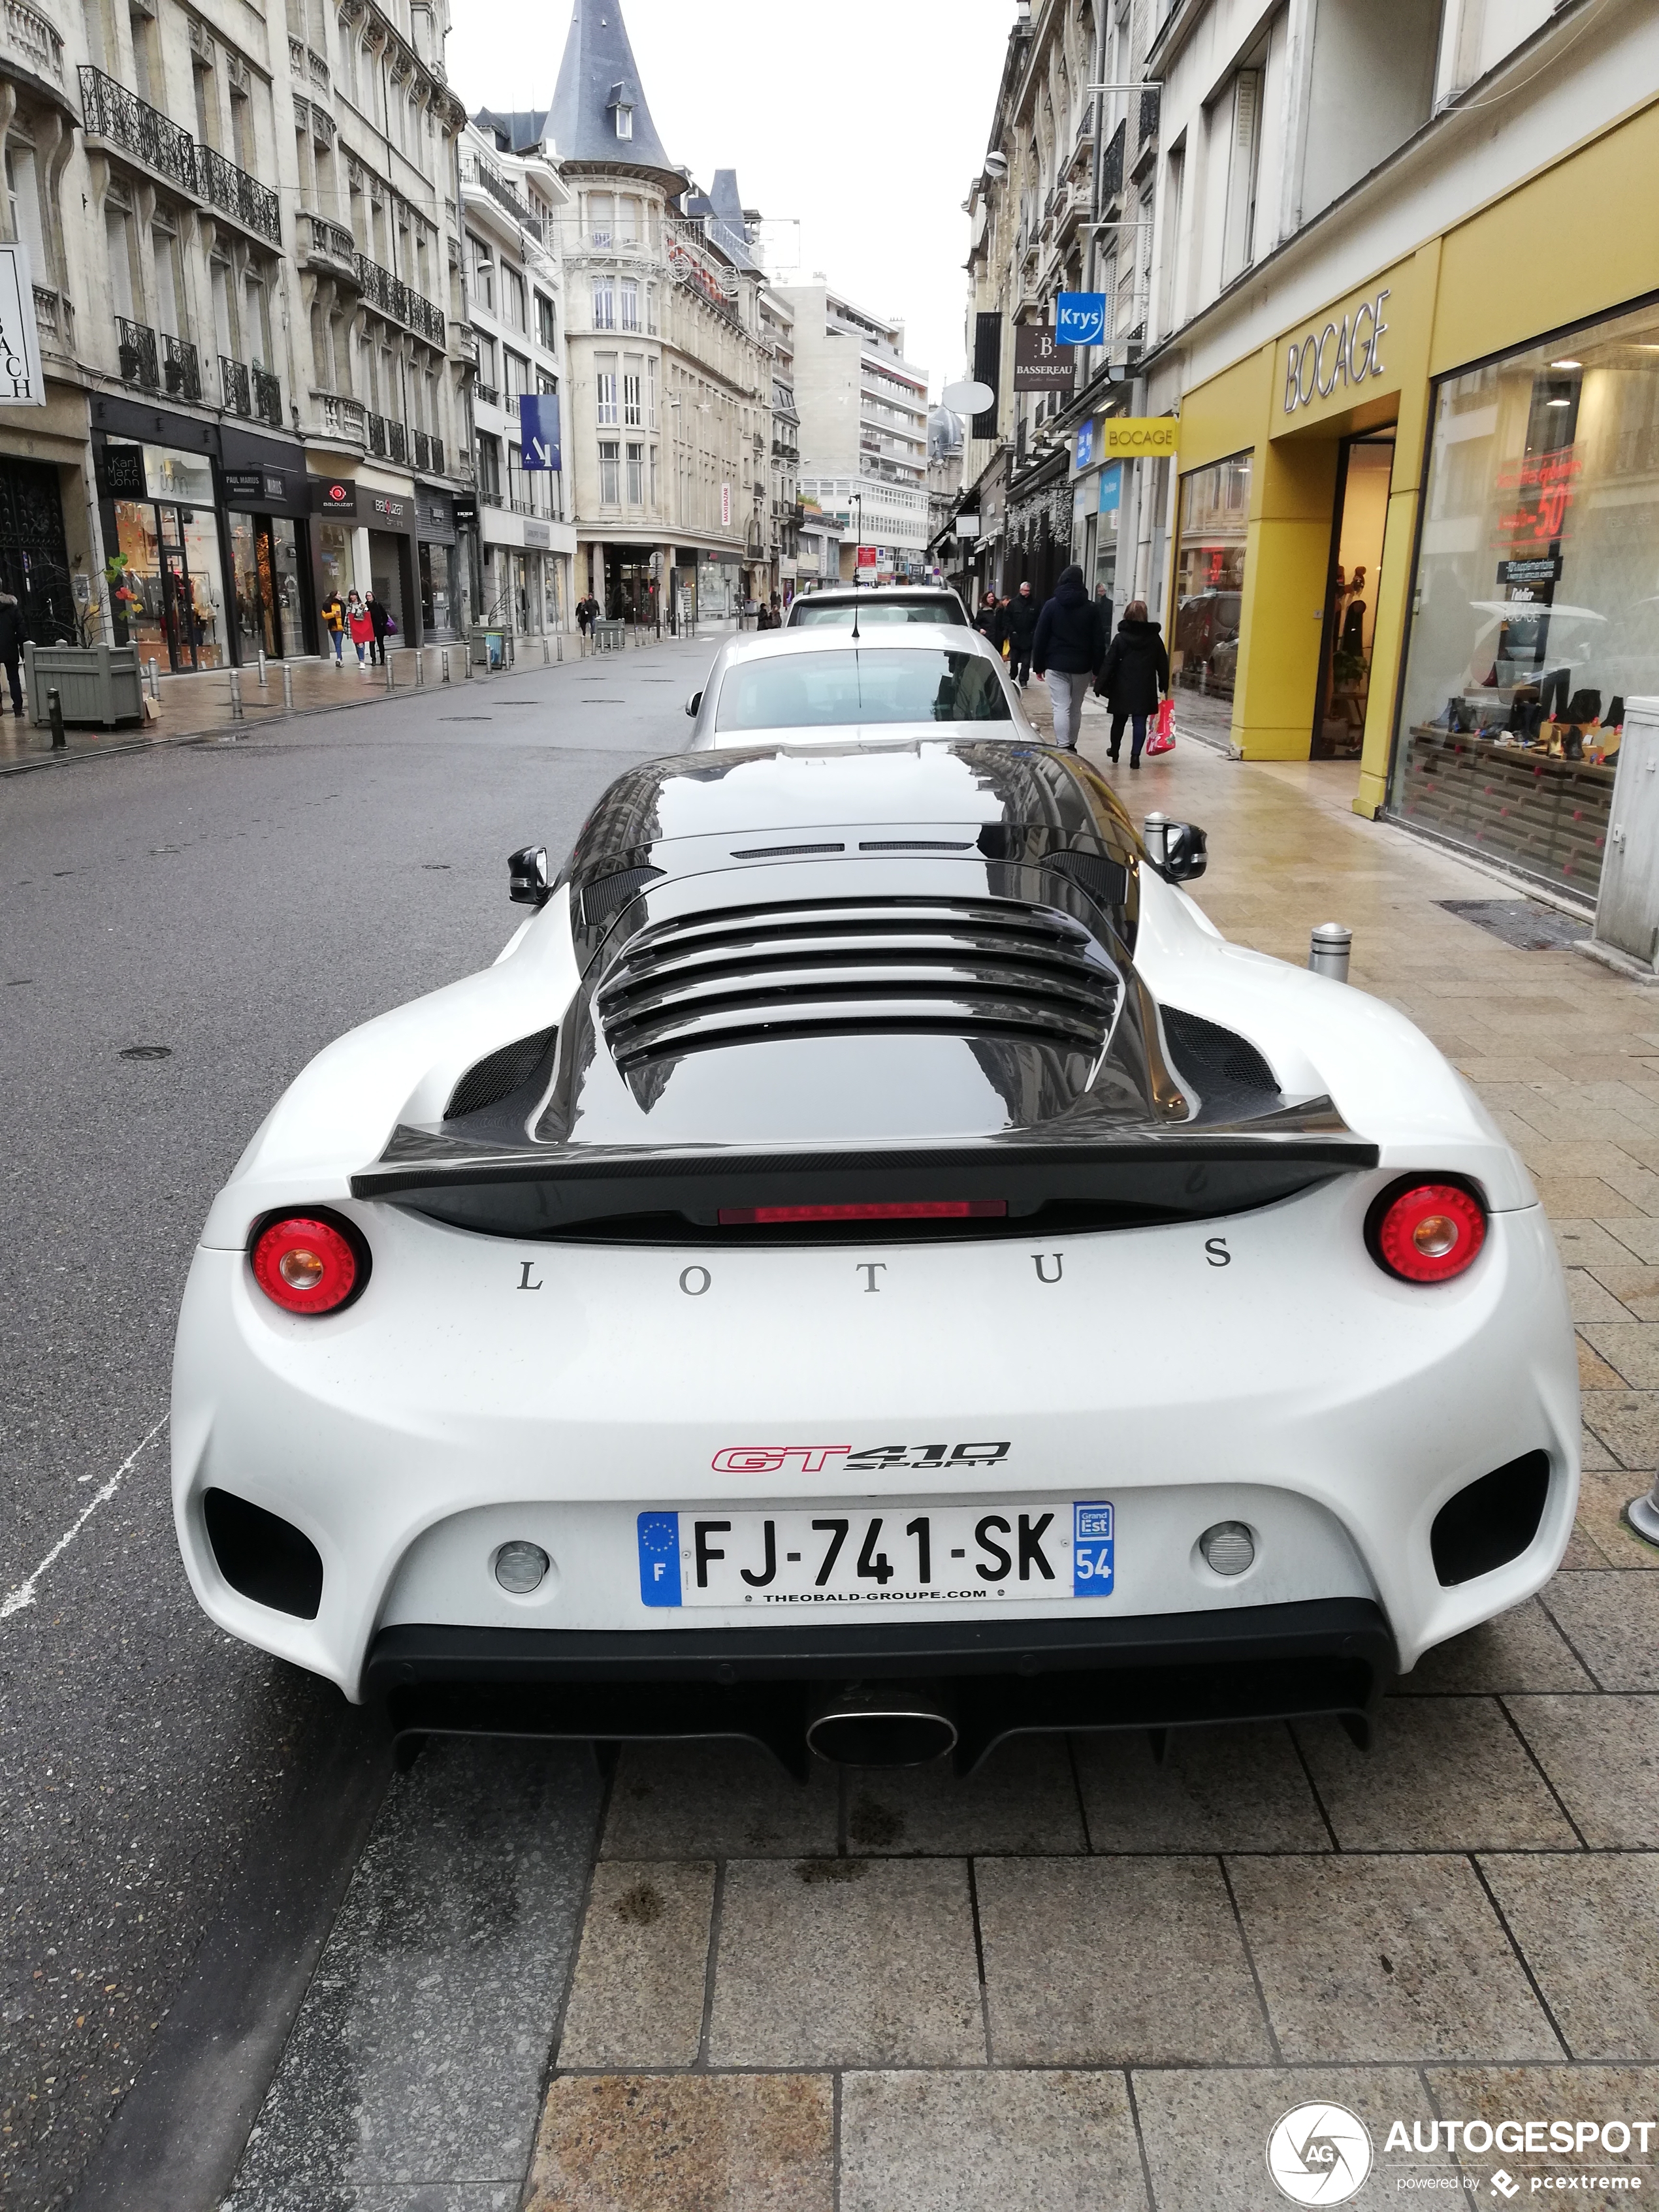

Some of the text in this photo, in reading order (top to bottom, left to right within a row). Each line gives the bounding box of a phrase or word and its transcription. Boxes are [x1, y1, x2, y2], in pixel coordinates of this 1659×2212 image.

[1061, 308, 1099, 330] Krys
[1040, 337, 1053, 355] B
[1284, 289, 1391, 413] BOCAGE
[1016, 366, 1073, 375] BASSEREAU
[1109, 430, 1172, 445] BOCAGE
[112, 456, 138, 468] Karl
[108, 466, 138, 477] Marc
[109, 475, 140, 487] John
[516, 1236, 1232, 1296] LOTUS
[711, 1441, 1012, 1473] GT 410
[843, 1458, 1008, 1471] SPORT
[1081, 1511, 1108, 1520] Grand
[1081, 1519, 1108, 1533] Est
[694, 1513, 1055, 1588] FJ-741-SK
[654, 1562, 666, 1581] F
[1076, 1548, 1112, 1580] 54
[763, 1590, 987, 1603] THEOBALD-GROUPE.COM
